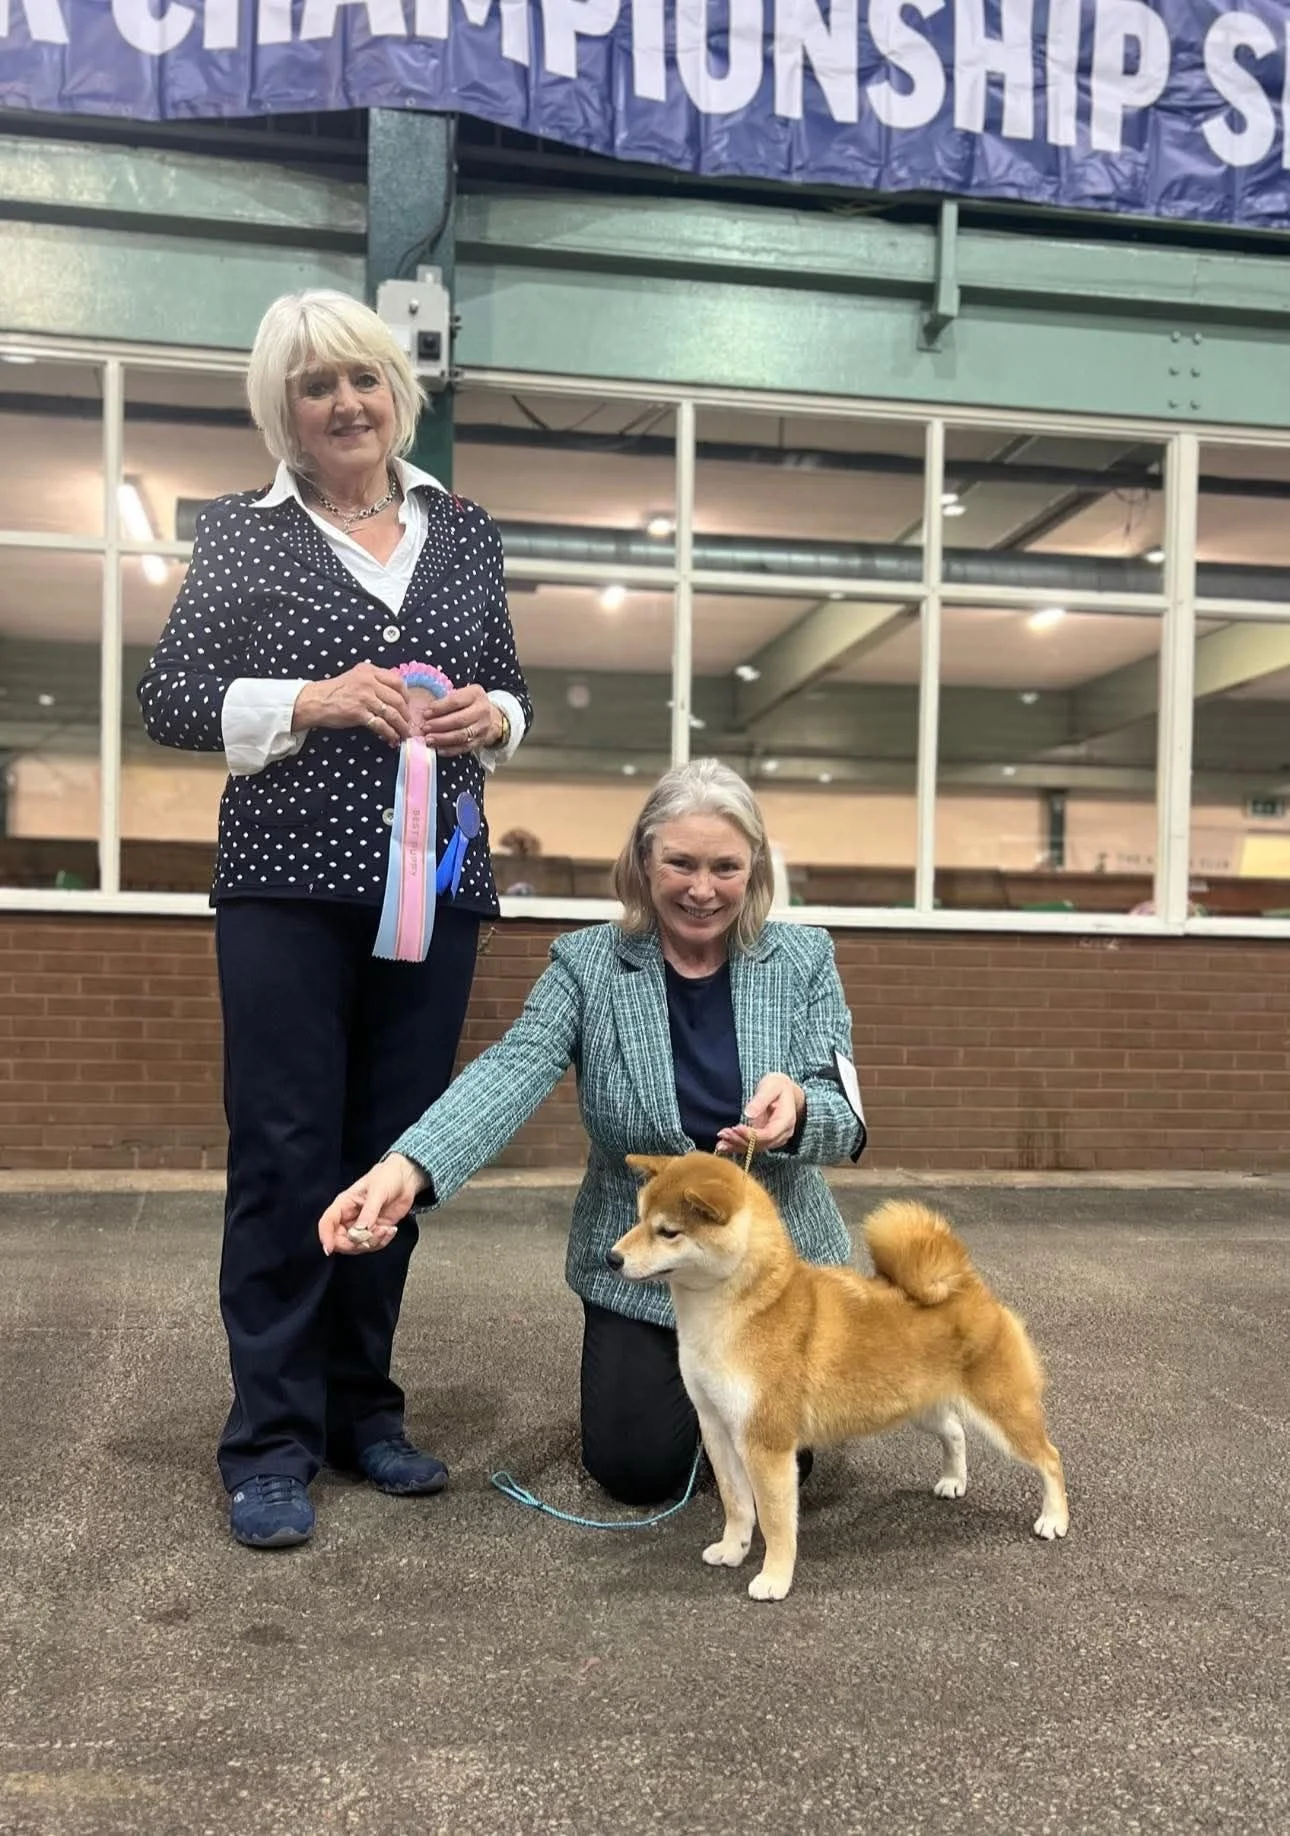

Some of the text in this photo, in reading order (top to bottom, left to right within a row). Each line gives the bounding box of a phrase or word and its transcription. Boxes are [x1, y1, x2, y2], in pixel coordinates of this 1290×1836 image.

[112, 0, 1290, 170] PIONSHIP S
[409, 809, 421, 877] BEST PUPPY
